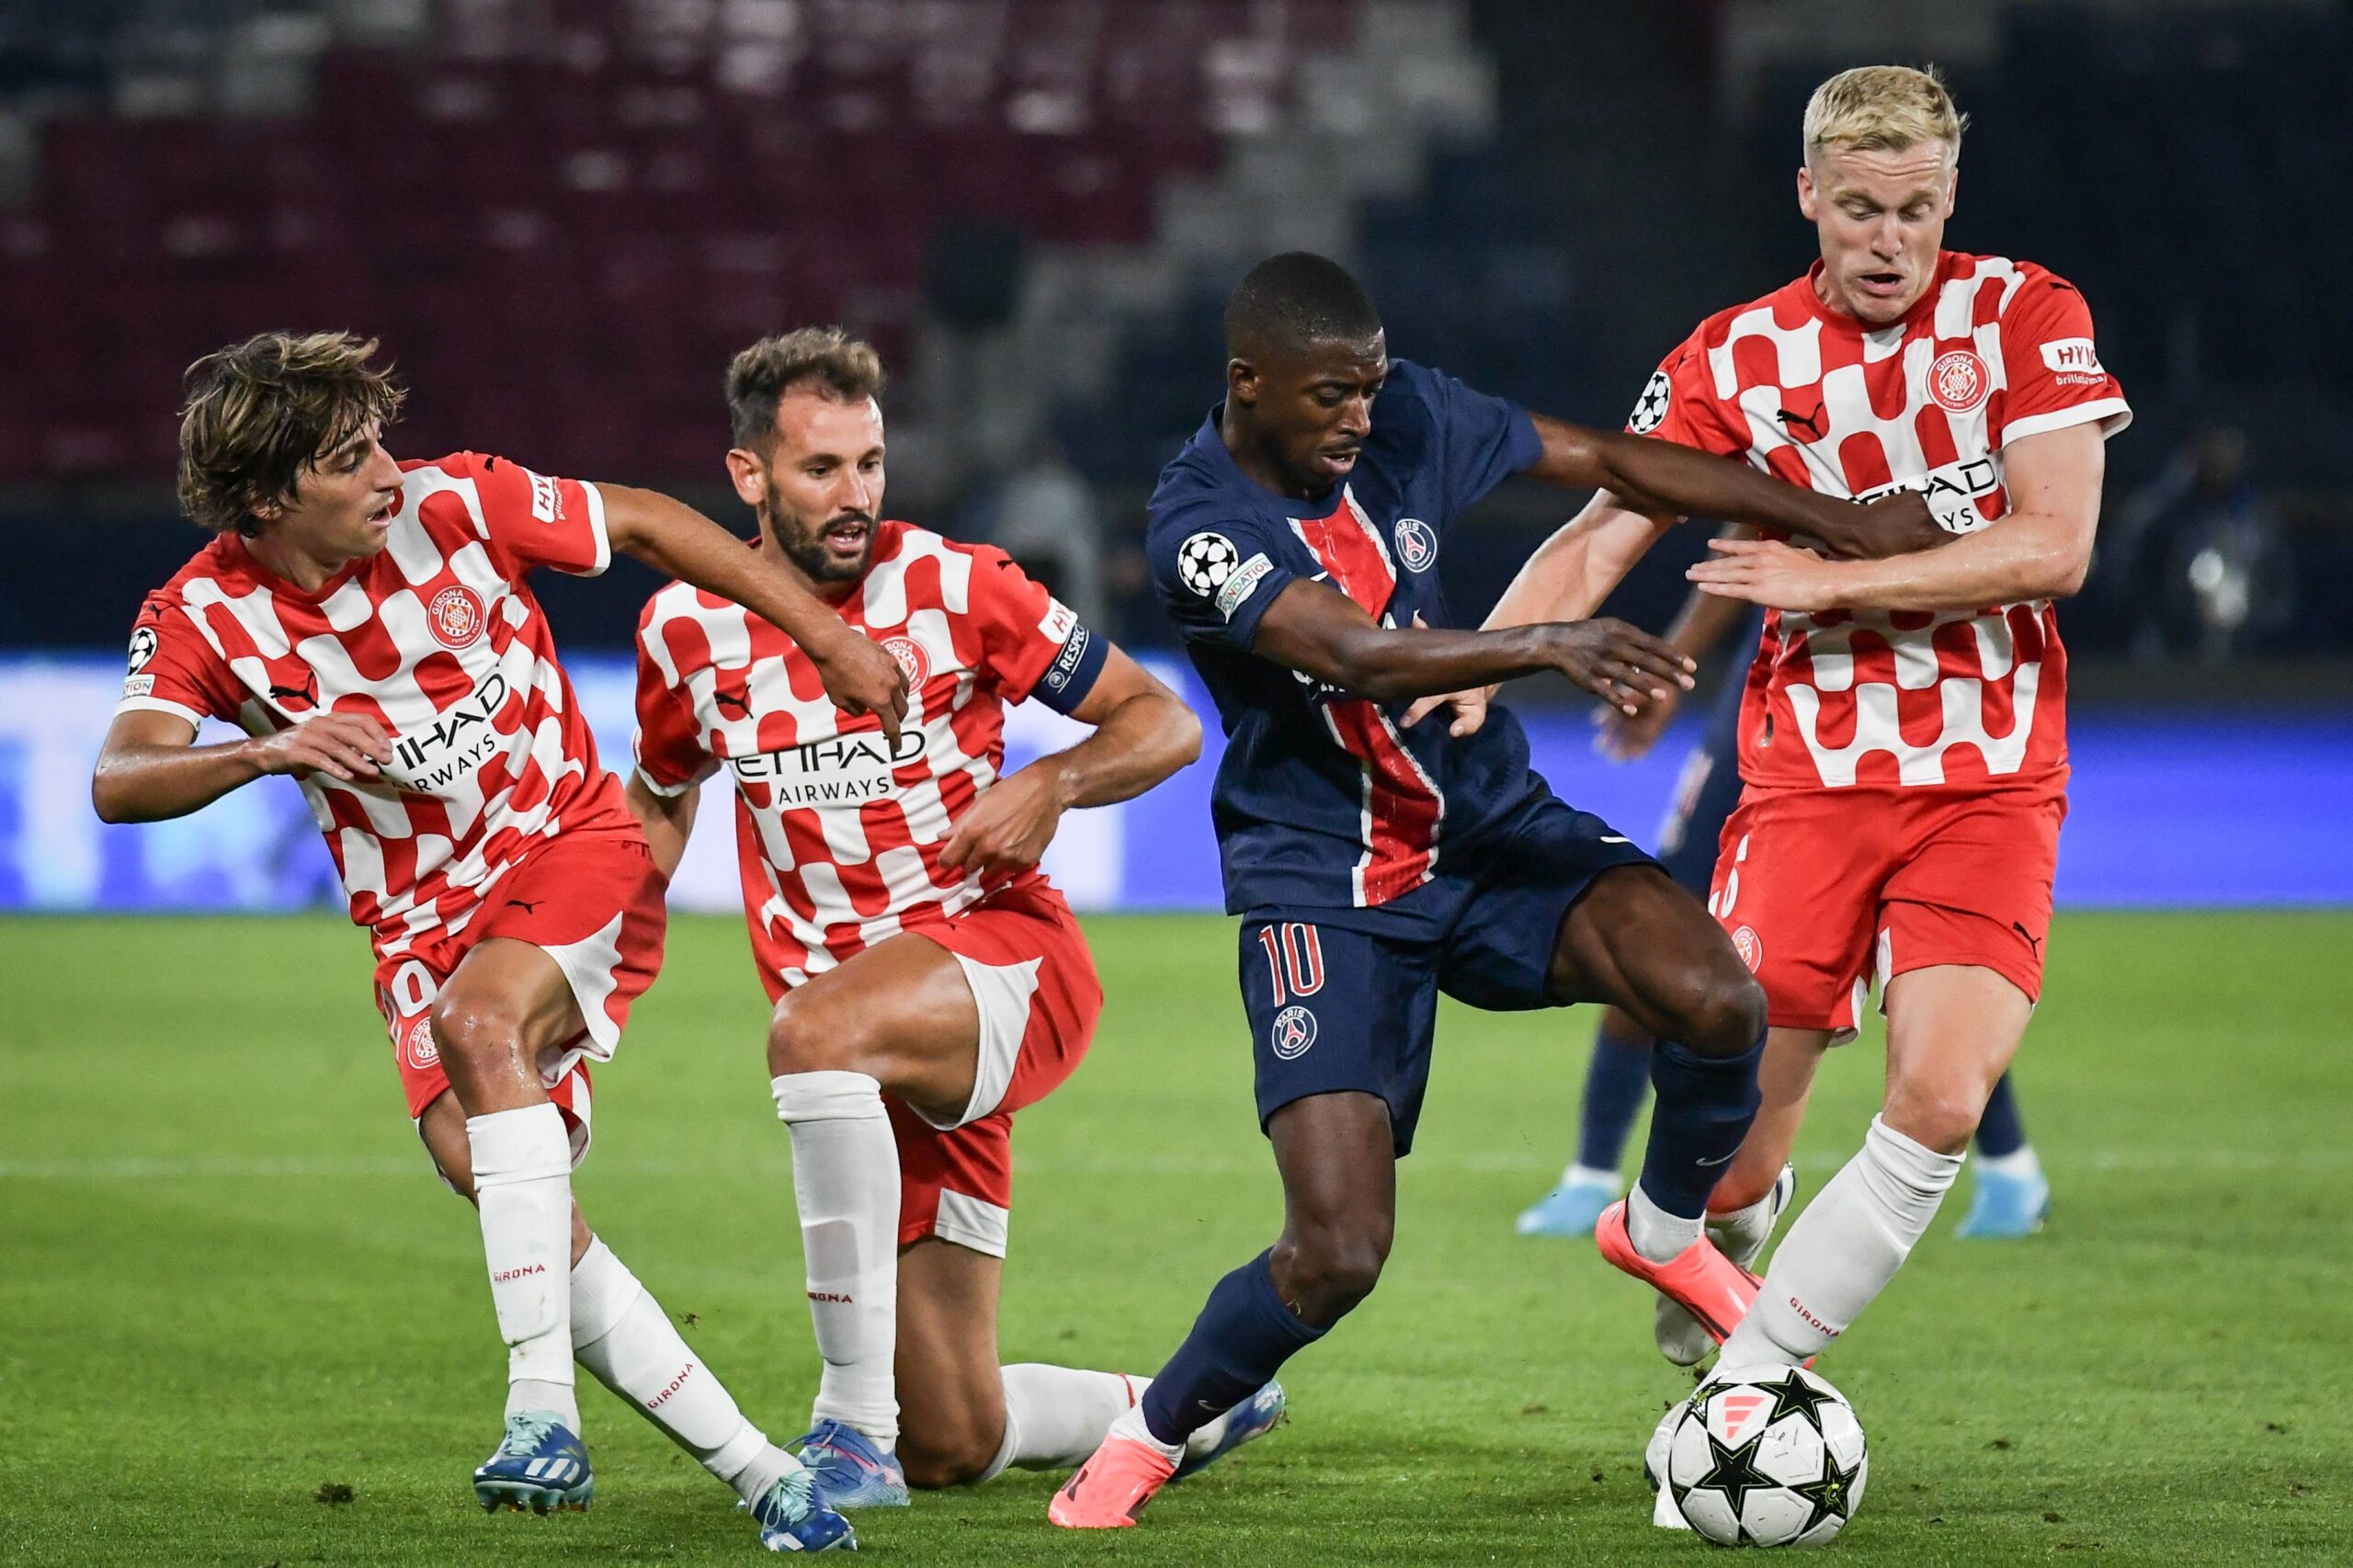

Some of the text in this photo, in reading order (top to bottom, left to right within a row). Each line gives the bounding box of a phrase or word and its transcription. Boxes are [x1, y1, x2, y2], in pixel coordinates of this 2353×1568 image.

[1936, 355, 1974, 371] GIRONA
[432, 589, 464, 615] GIRONA
[884, 641, 914, 653] RONA
[1059, 623, 1086, 672] RESPEC
[371, 673, 506, 775] IHAD
[735, 731, 926, 778] ETIHAD
[779, 777, 890, 806] AIRWAYS
[1258, 922, 1325, 1008] 10
[1277, 1008, 1305, 1028] PARIS
[494, 1263, 545, 1282] GIRONA
[1789, 1297, 1840, 1337] GIRONA
[647, 1362, 694, 1409] GIRONA
